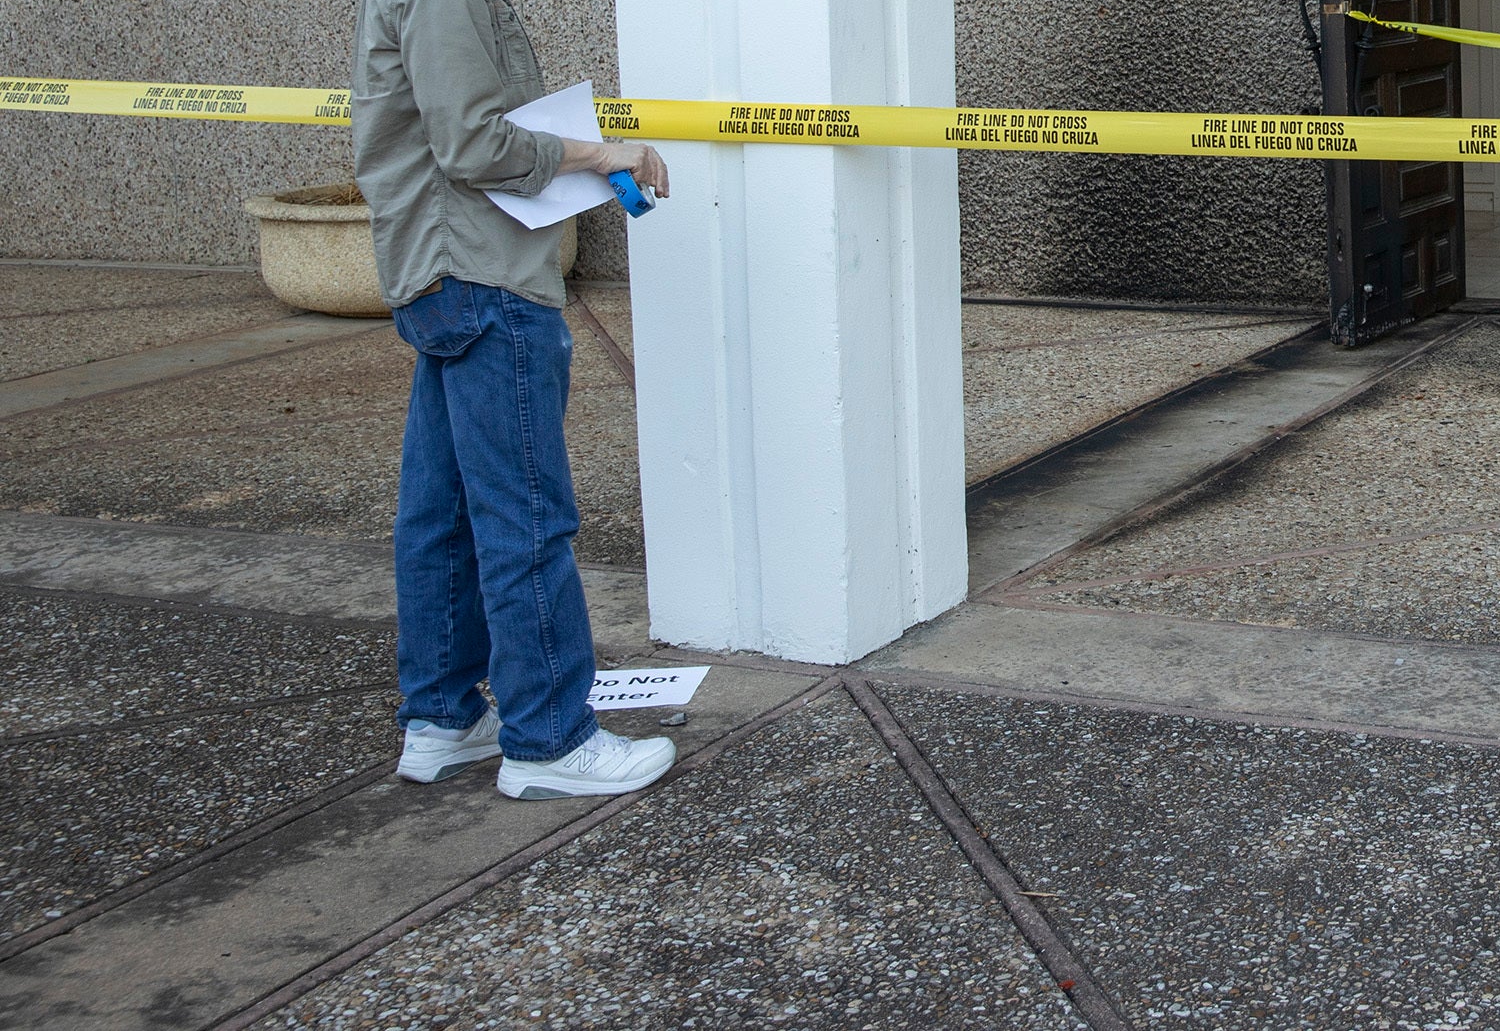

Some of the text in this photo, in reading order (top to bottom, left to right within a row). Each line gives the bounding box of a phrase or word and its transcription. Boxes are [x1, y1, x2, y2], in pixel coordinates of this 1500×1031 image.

[0, 81, 68, 93] INE DO NOT CROSS
[3, 92, 70, 105] FUEGO NO CRUZA
[146, 87, 244, 101] FIRE LINE DO NOT CROSS
[327, 94, 346, 105] FIRE
[133, 98, 247, 114] LINEA DEL FUEGO NO CRUZA
[315, 106, 341, 118] LINEA
[603, 103, 632, 115] CROSS
[731, 107, 850, 122] FIRE LINE DO NOT CROSS
[957, 113, 1087, 129] FIRE LINE DO NOT CROSS
[609, 117, 639, 130] CRUZA
[719, 121, 859, 138] LINEA DEL FUEGO NO CRUZA
[1203, 119, 1344, 135] FIRE LINE DO NOT CROSS
[946, 127, 1098, 145] LINEA DEL FUEGO NO CRUZA
[1471, 125, 1497, 138] FIRE
[1192, 134, 1357, 152] LINEA DEL FUEGO NO CRUZA
[1459, 140, 1496, 154] LINEA
[628, 675, 681, 685] Not
[586, 691, 659, 702] Enter
